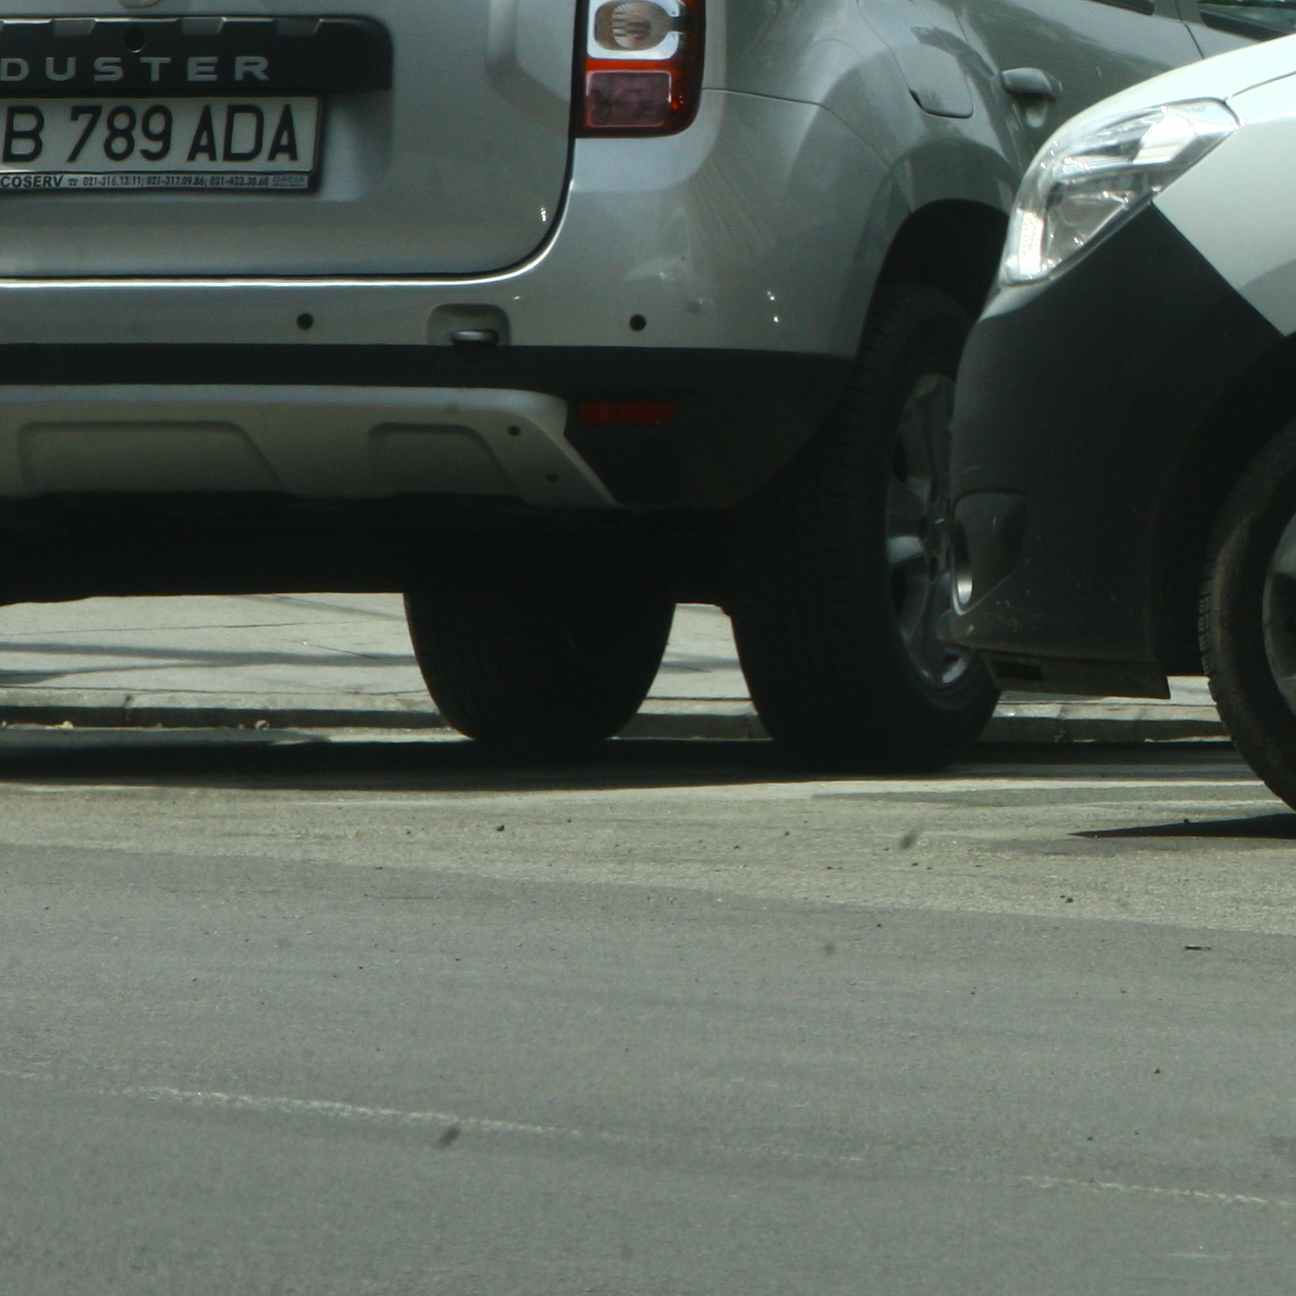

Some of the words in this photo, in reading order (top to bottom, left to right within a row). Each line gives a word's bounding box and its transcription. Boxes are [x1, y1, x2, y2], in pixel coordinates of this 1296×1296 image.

[0, 56, 269, 82] DUSTER
[3, 106, 45, 163] B
[66, 106, 173, 162] 789
[186, 105, 298, 162] ADA
